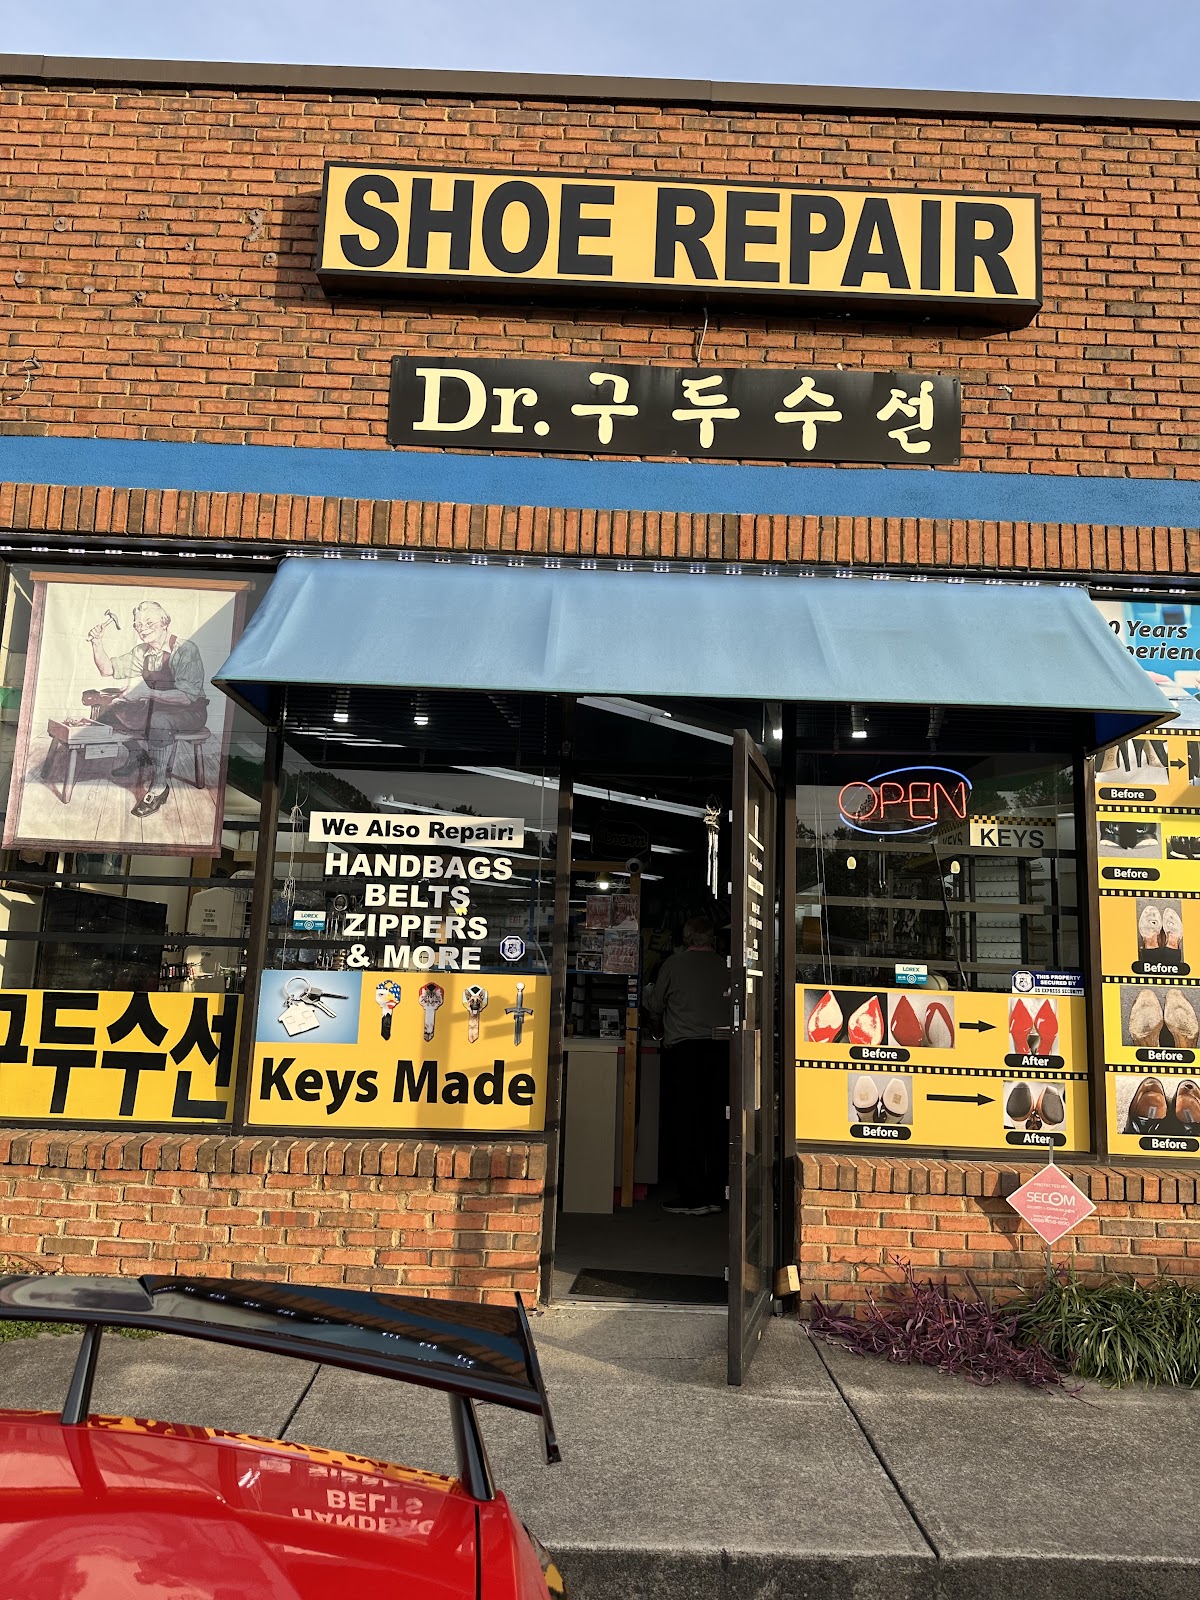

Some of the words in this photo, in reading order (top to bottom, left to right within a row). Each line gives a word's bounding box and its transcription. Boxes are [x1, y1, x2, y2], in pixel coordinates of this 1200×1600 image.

[339, 173, 616, 276] SHOE
[654, 187, 1018, 296] REPAIR
[412, 366, 551, 437] Dr.
[570, 371, 934, 454] 구두수선
[1126, 620, 1188, 639] Years
[838, 781, 967, 821] OPEN
[1110, 789, 1144, 799] Before
[322, 818, 359, 836] We
[366, 819, 420, 839] Also
[428, 821, 514, 843] Repair!
[980, 828, 1044, 849] KEYS
[325, 852, 513, 881] HANDBAGS
[1113, 868, 1148, 879] Before
[364, 884, 470, 910] BELTS
[343, 913, 488, 940] ZIPPERS
[346, 943, 371, 968] &
[383, 945, 481, 971] MORE
[1143, 962, 1178, 973] Before
[861, 1048, 898, 1060] Before
[1021, 1055, 1049, 1067] After
[1148, 1050, 1183, 1061] Before
[259, 1057, 379, 1116] Keys
[392, 1059, 537, 1106] Made
[862, 1126, 899, 1138] Before
[1022, 1133, 1051, 1145] After
[1151, 1139, 1187, 1149] Before
[1026, 1191, 1076, 1207] SECOM
